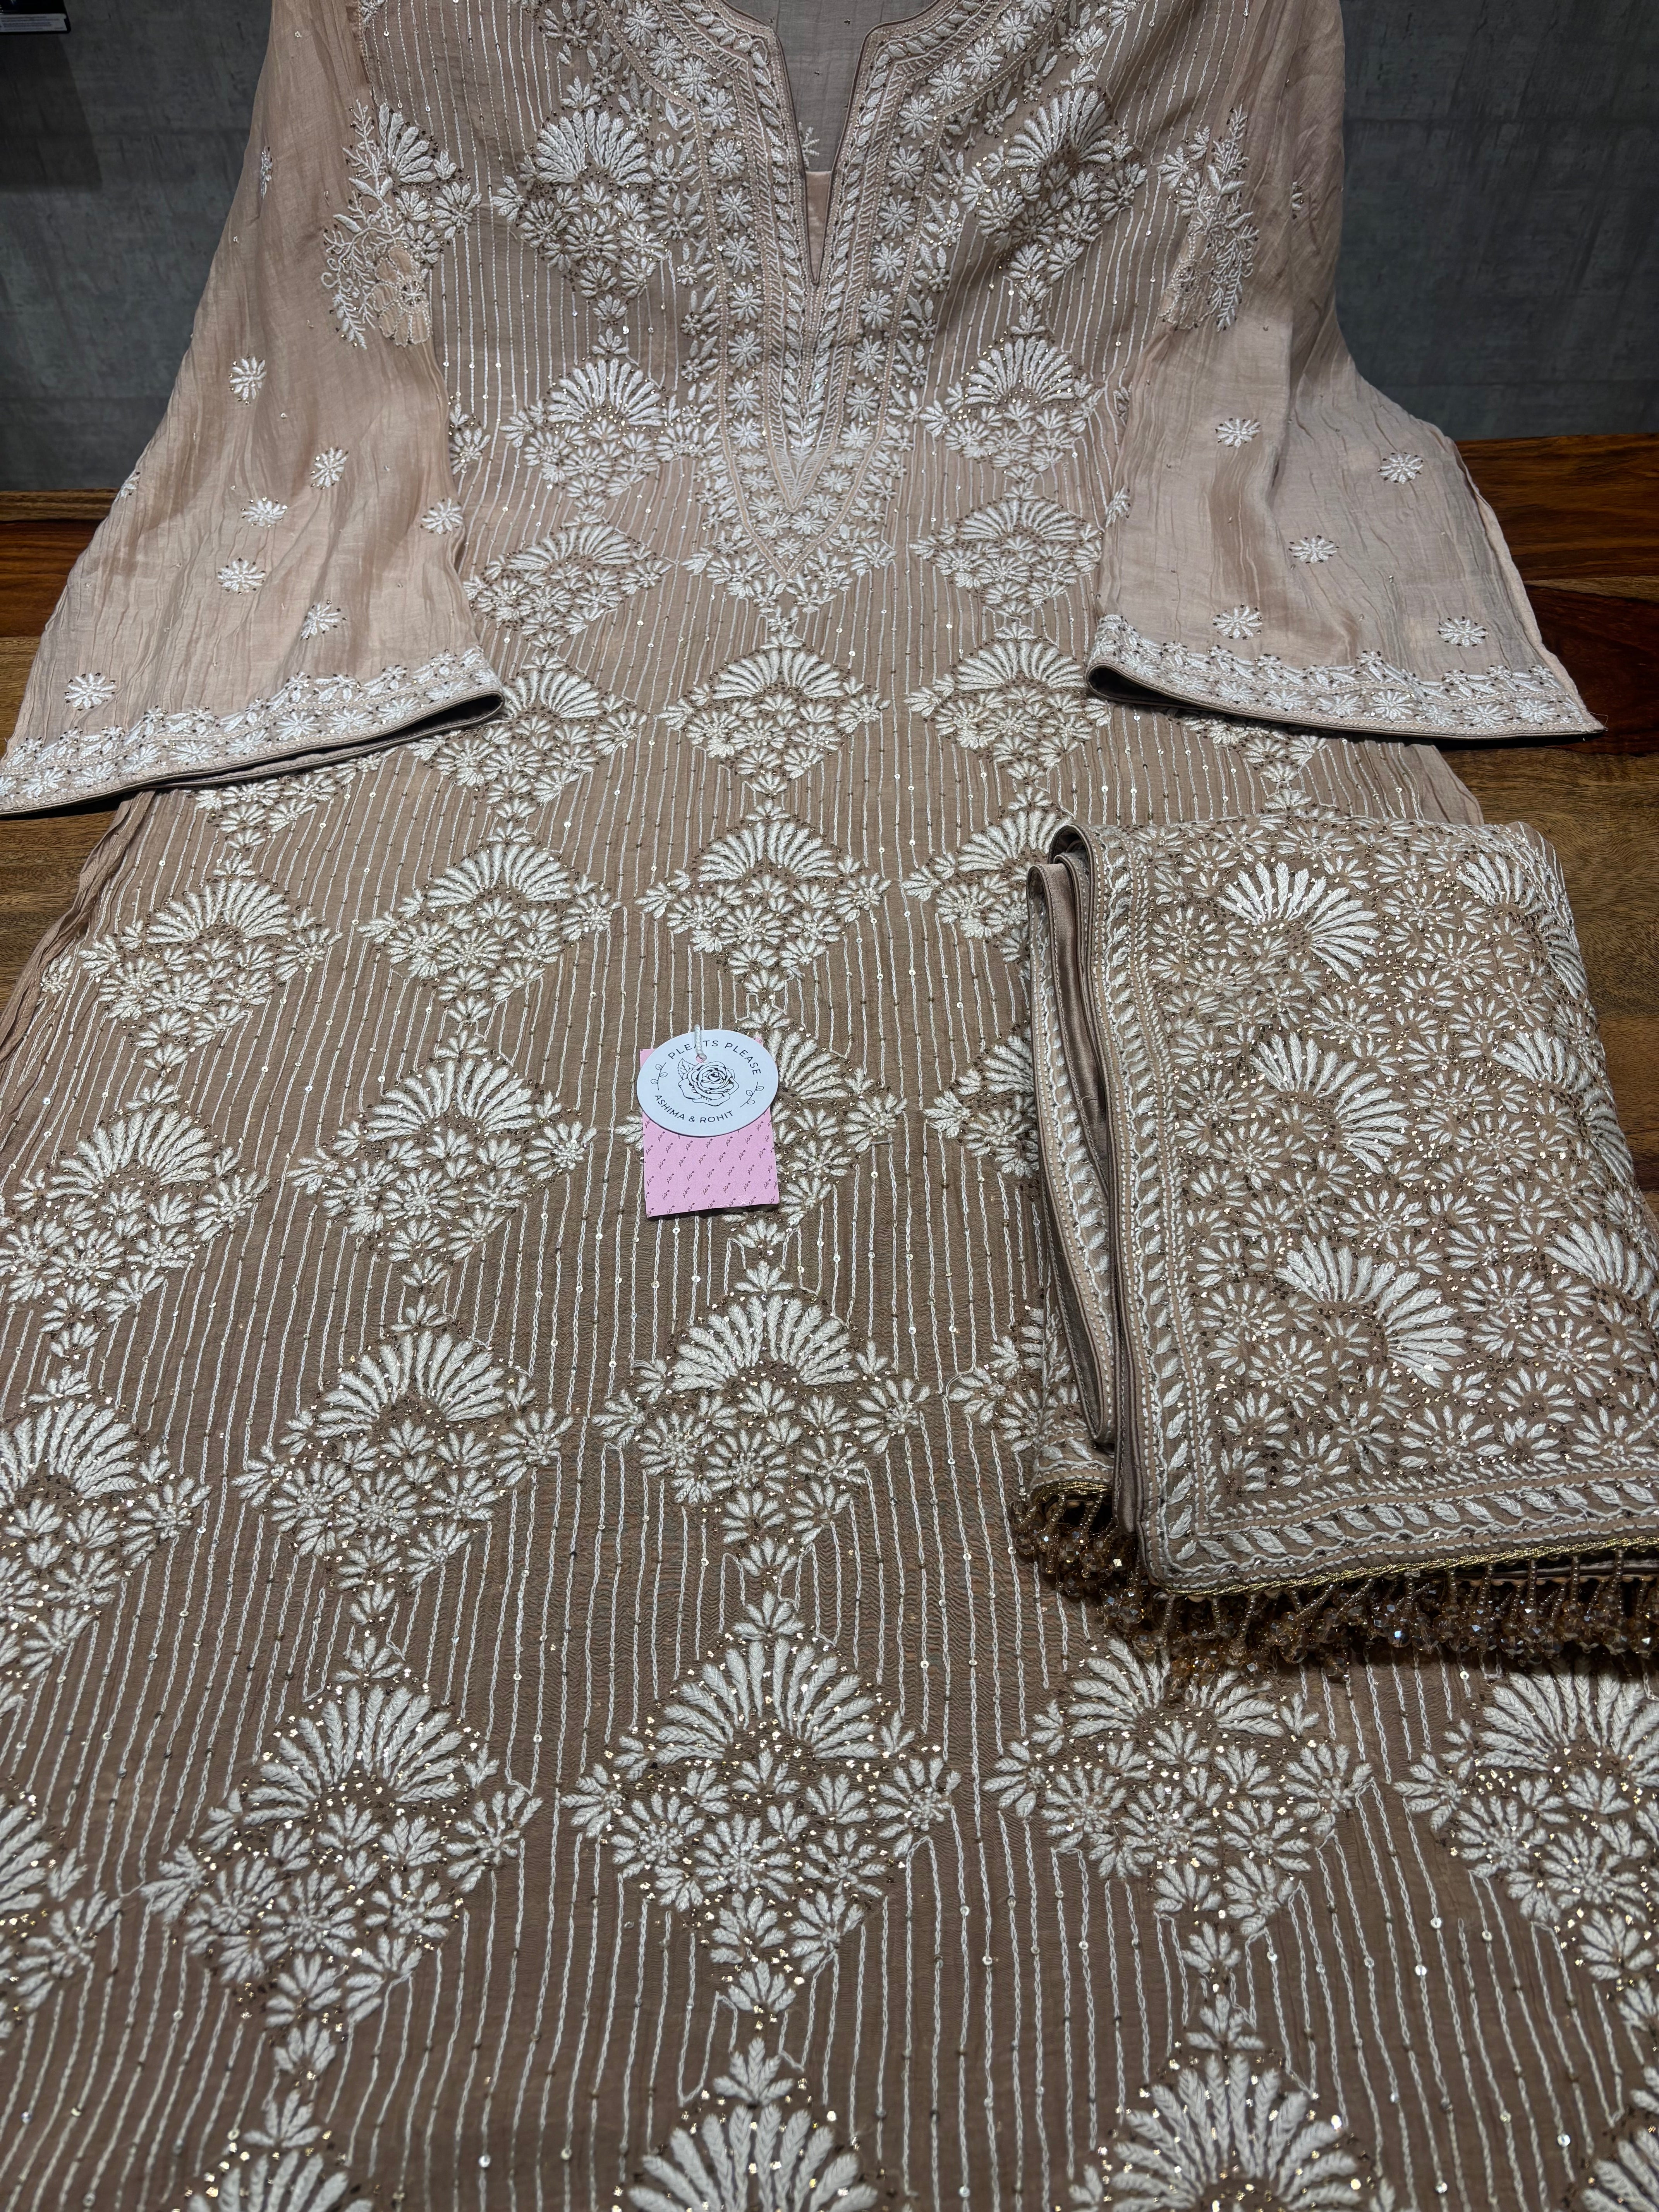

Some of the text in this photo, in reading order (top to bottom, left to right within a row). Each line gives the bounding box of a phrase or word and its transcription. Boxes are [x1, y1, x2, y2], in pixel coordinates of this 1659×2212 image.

[667, 1040, 761, 1075] PLETS PLEASE
[654, 1095, 684, 1120] ASHIMA
[700, 1110, 733, 1123] ROHIT
